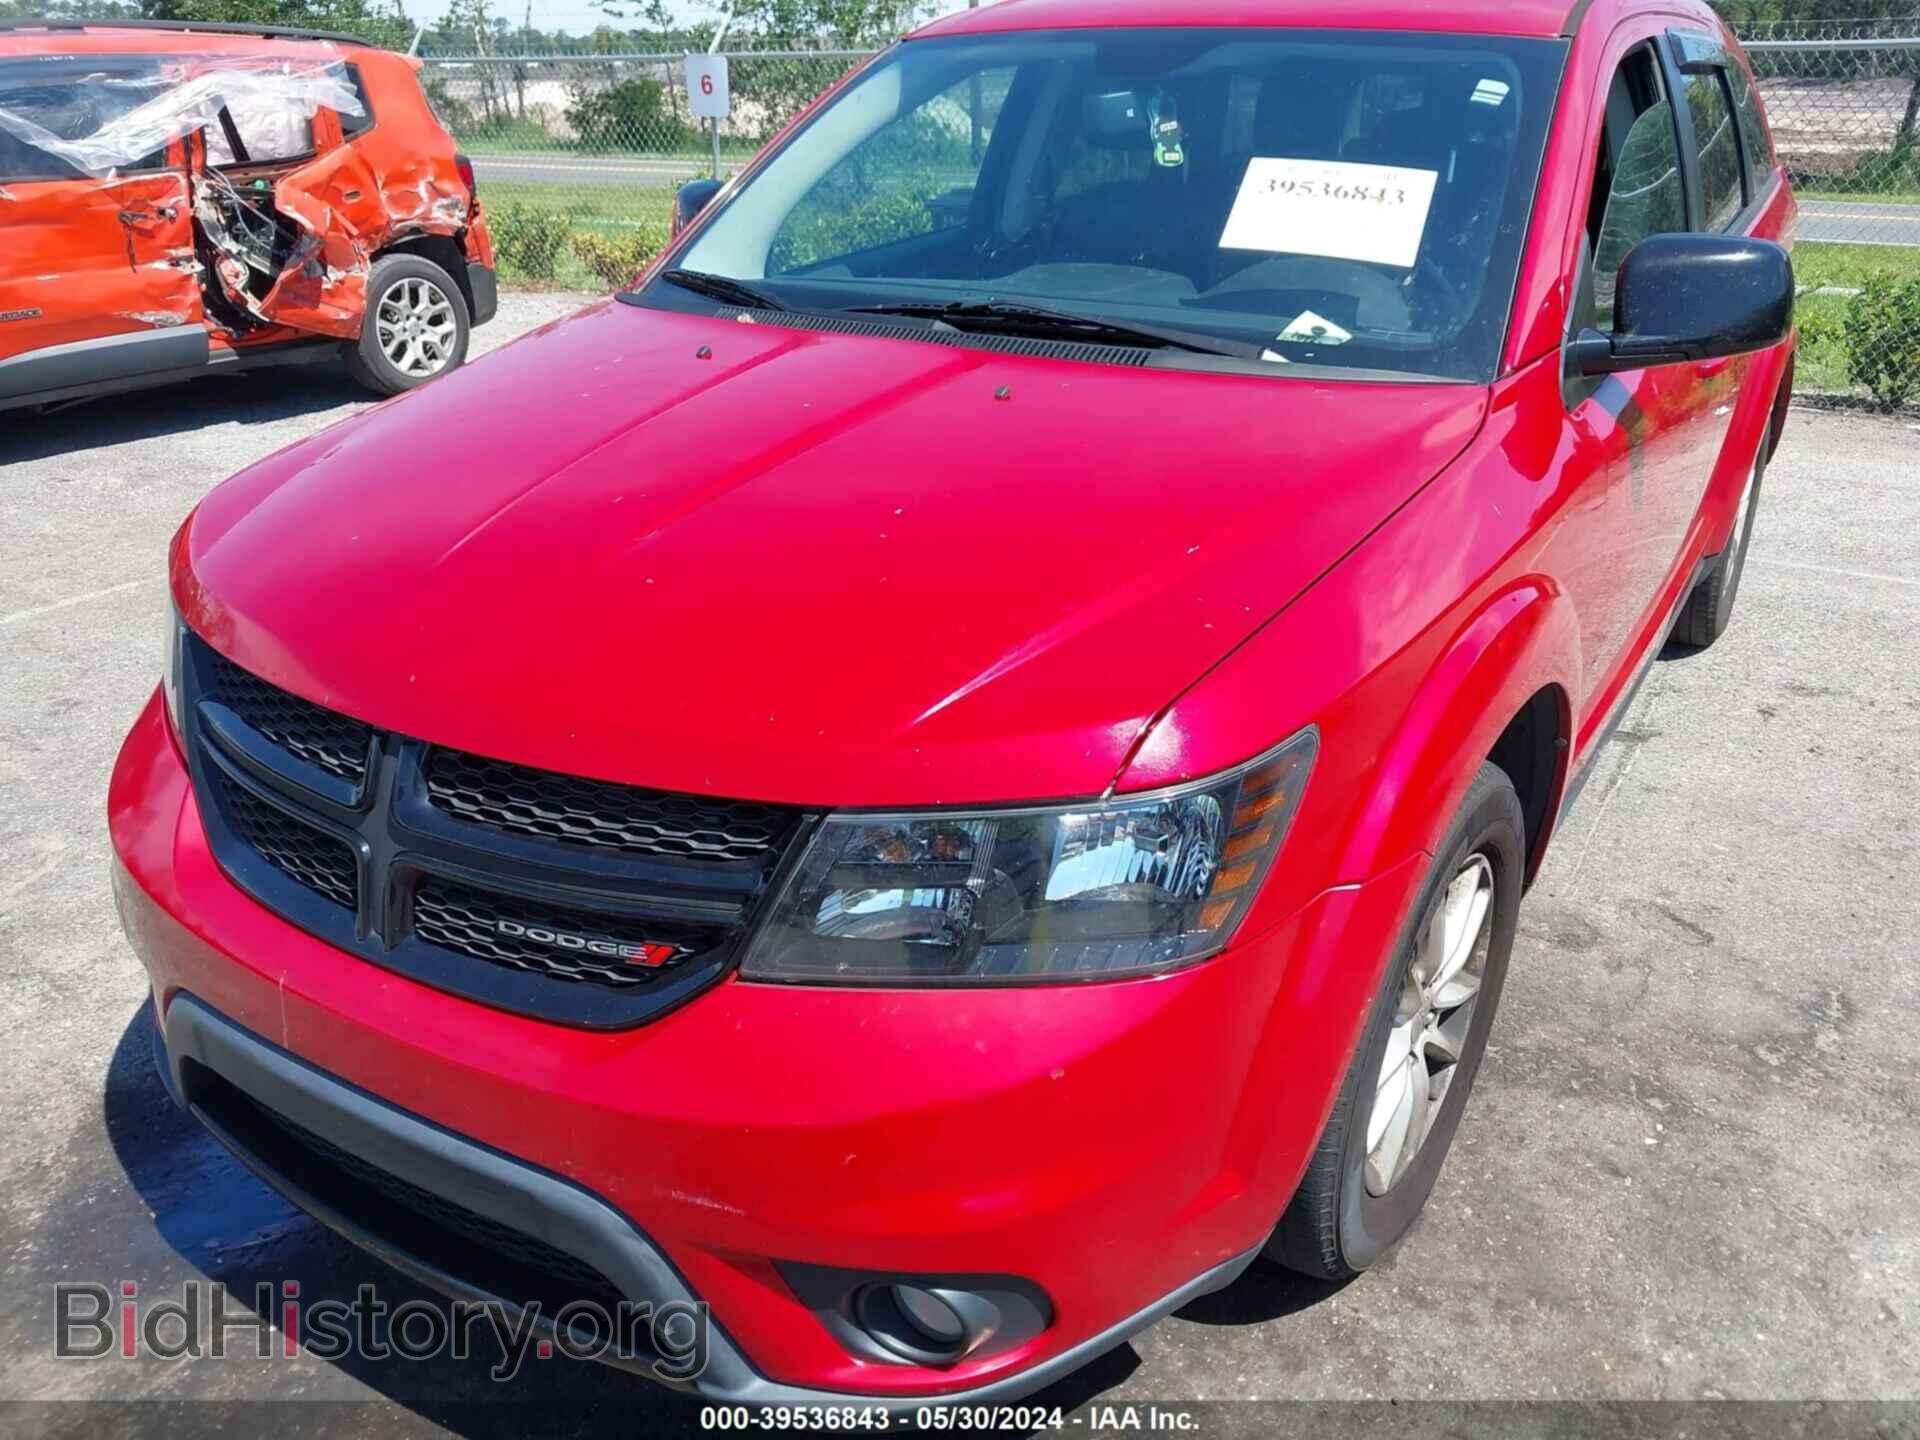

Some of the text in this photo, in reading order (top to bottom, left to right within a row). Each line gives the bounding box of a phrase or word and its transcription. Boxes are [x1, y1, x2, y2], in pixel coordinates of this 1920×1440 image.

[701, 74, 713, 95] 6
[1260, 178, 1405, 204] 39536843
[498, 919, 650, 960] DODGE
